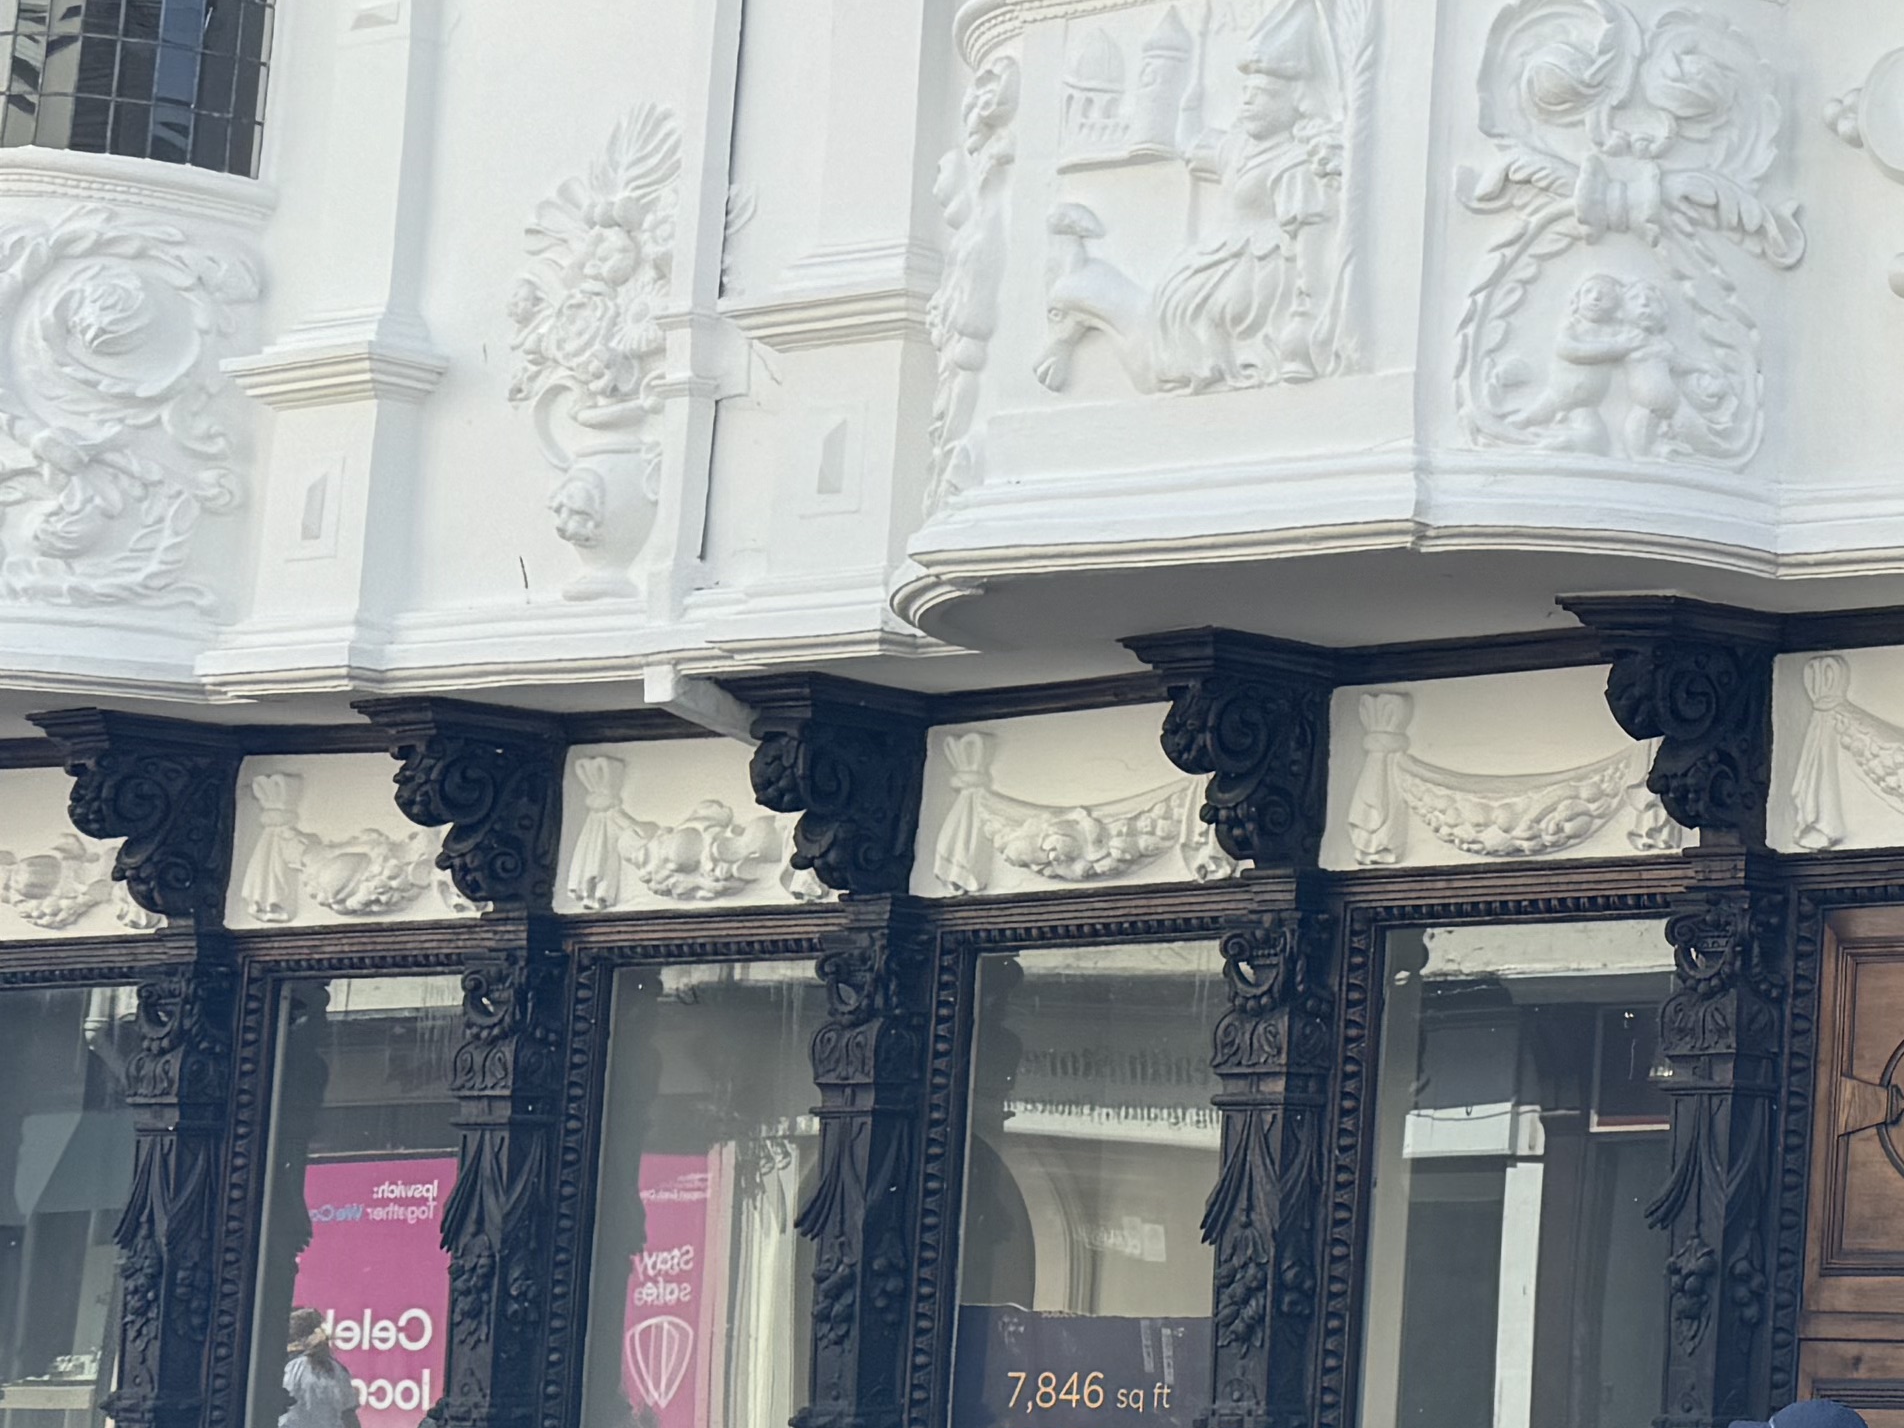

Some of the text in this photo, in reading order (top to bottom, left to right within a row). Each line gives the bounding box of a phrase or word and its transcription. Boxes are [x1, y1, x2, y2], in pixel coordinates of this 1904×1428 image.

[1006, 1371, 1172, 1414] 7,846 sq ft
